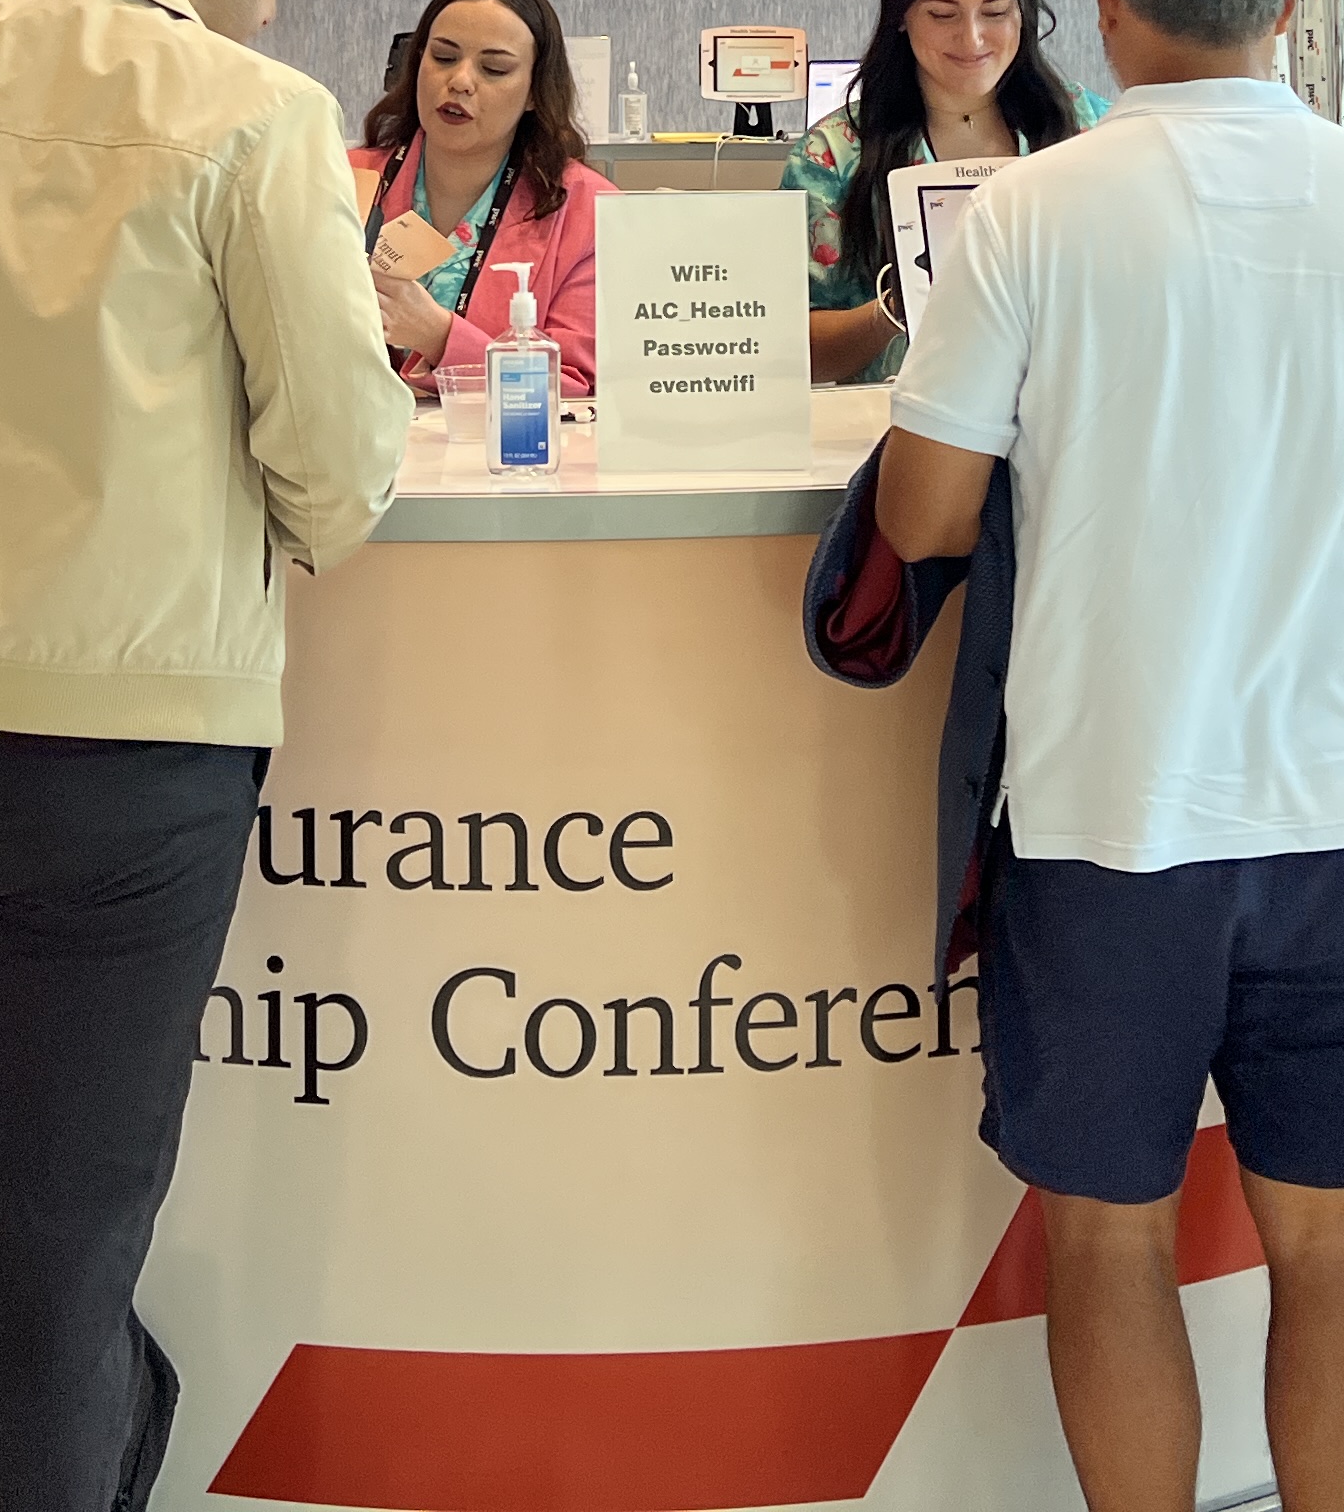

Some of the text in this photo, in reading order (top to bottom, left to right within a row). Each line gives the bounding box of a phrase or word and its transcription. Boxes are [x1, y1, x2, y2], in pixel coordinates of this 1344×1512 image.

[670, 264, 729, 282] WiFi:
[634, 300, 766, 322] ALC_Health
[643, 337, 760, 356] Password:
[649, 374, 755, 394] eventwifi
[502, 393, 526, 402] Hand
[502, 402, 543, 410] Sanitizer
